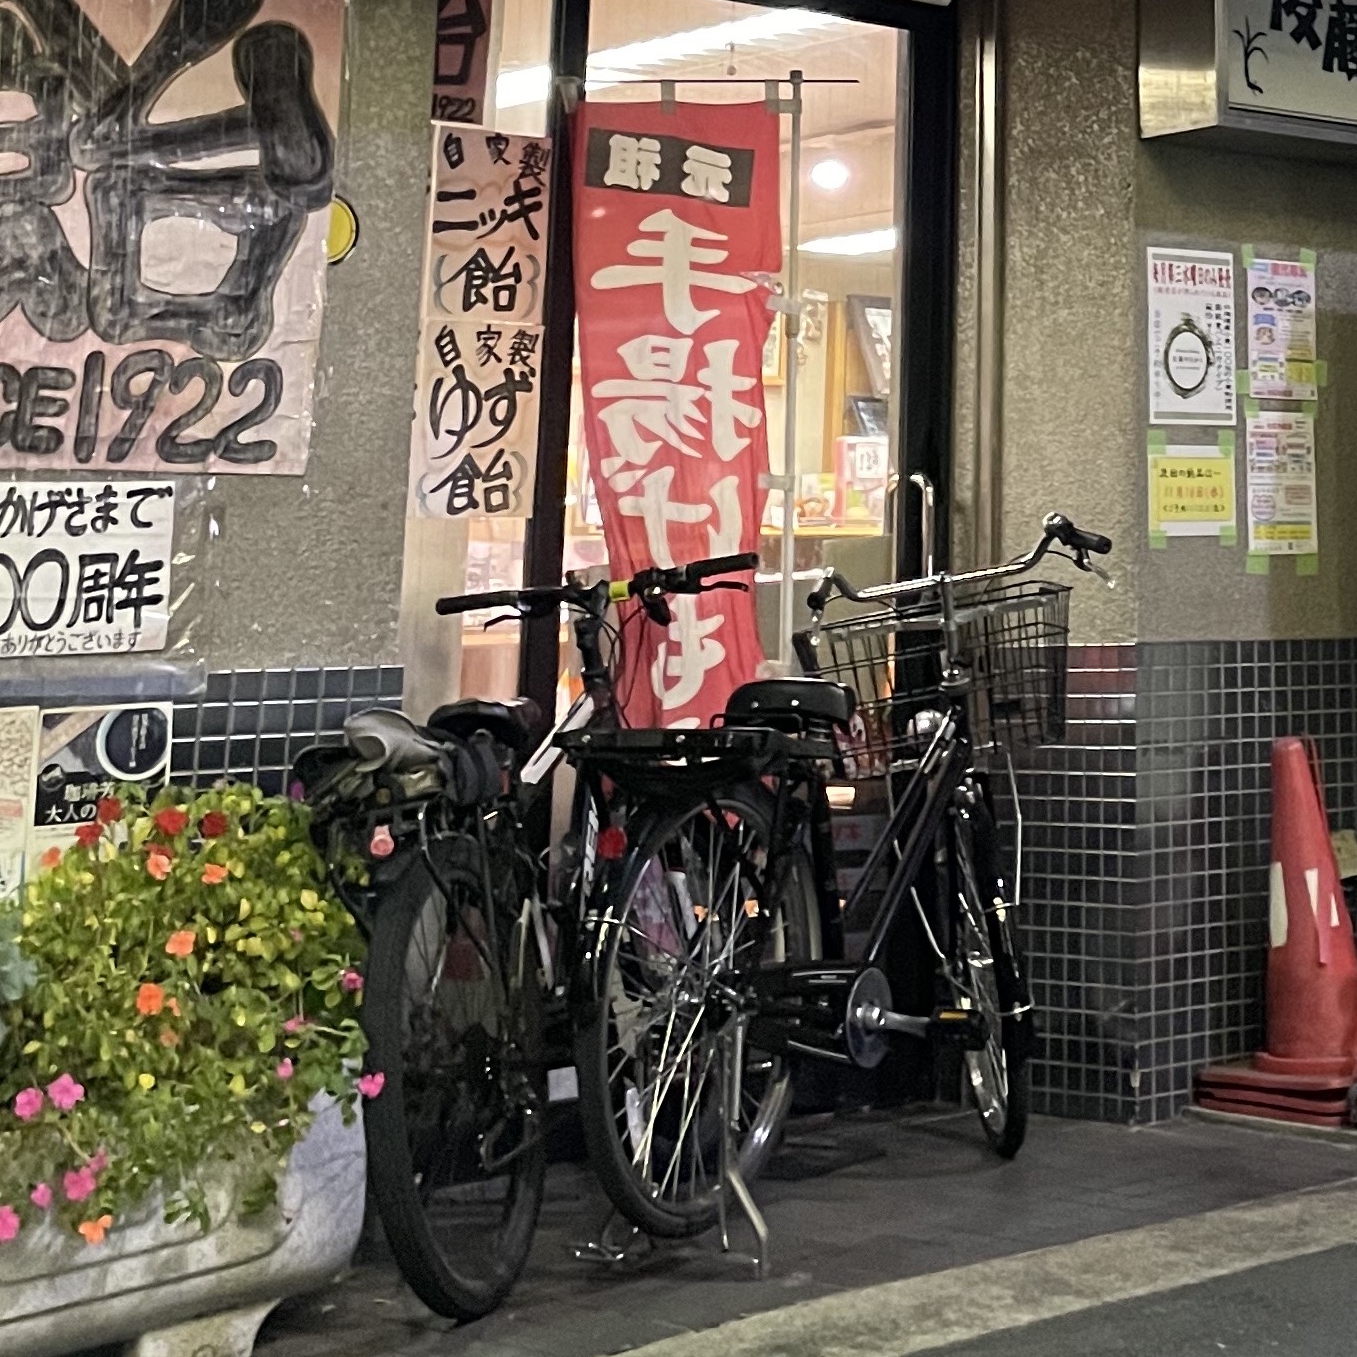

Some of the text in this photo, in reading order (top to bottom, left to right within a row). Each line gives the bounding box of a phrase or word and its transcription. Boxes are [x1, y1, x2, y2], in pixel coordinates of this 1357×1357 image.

[432, 179, 543, 240] ニッキ
[440, 246, 523, 312] 飴
[435, 324, 540, 377] 自家製
[429, 364, 533, 460] ゆず
[429, 448, 513, 515] 飴
